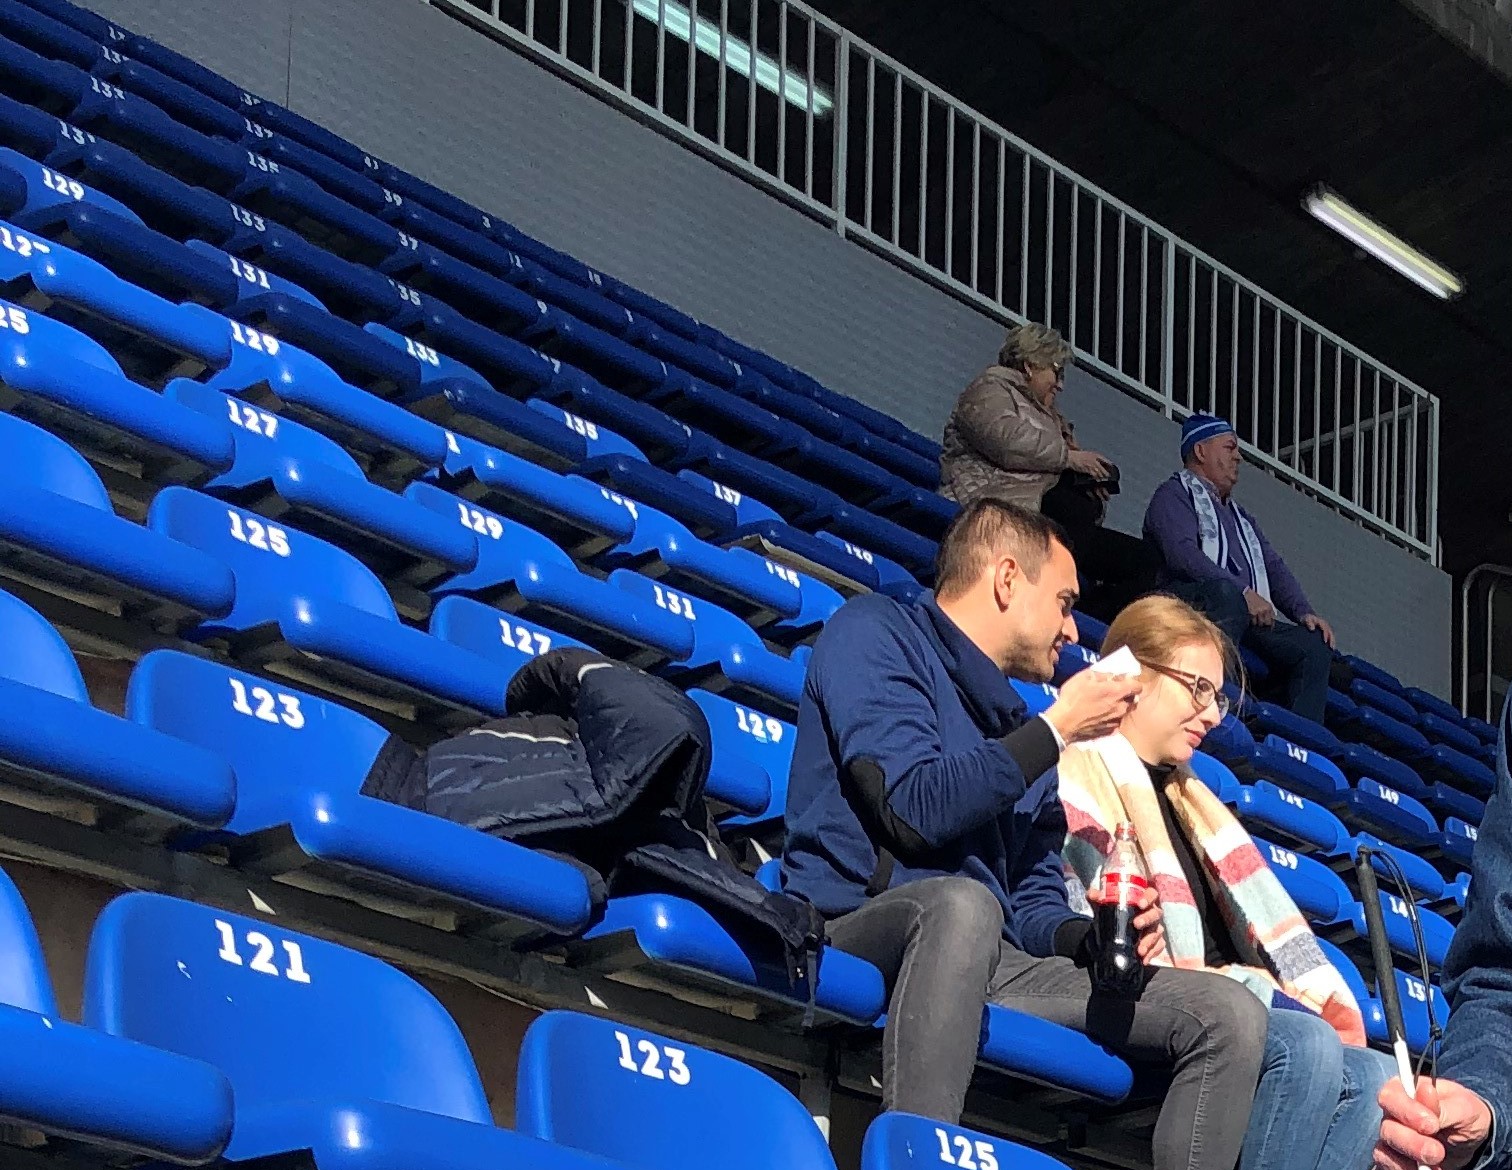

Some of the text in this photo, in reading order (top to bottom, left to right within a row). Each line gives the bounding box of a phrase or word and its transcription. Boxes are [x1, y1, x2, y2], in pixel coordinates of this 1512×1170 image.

[42, 167, 85, 201] 129
[230, 203, 266, 232] 133
[229, 255, 271, 290] 131
[229, 319, 280, 356] 129
[404, 336, 440, 366] 133
[226, 399, 278, 438] 127
[563, 411, 599, 440] 135
[712, 481, 742, 506] 137
[228, 510, 290, 556] 125
[458, 503, 504, 540] 129
[653, 585, 696, 621] 131
[499, 618, 552, 656] 127
[230, 679, 304, 728] 123
[734, 706, 783, 743] 129
[1286, 743, 1308, 763] 147
[1378, 784, 1400, 805] 149
[1463, 824, 1478, 842] 15
[1269, 845, 1298, 870] 139
[1389, 895, 1417, 922] 14
[216, 920, 310, 983] 121
[615, 1031, 690, 1084] 123
